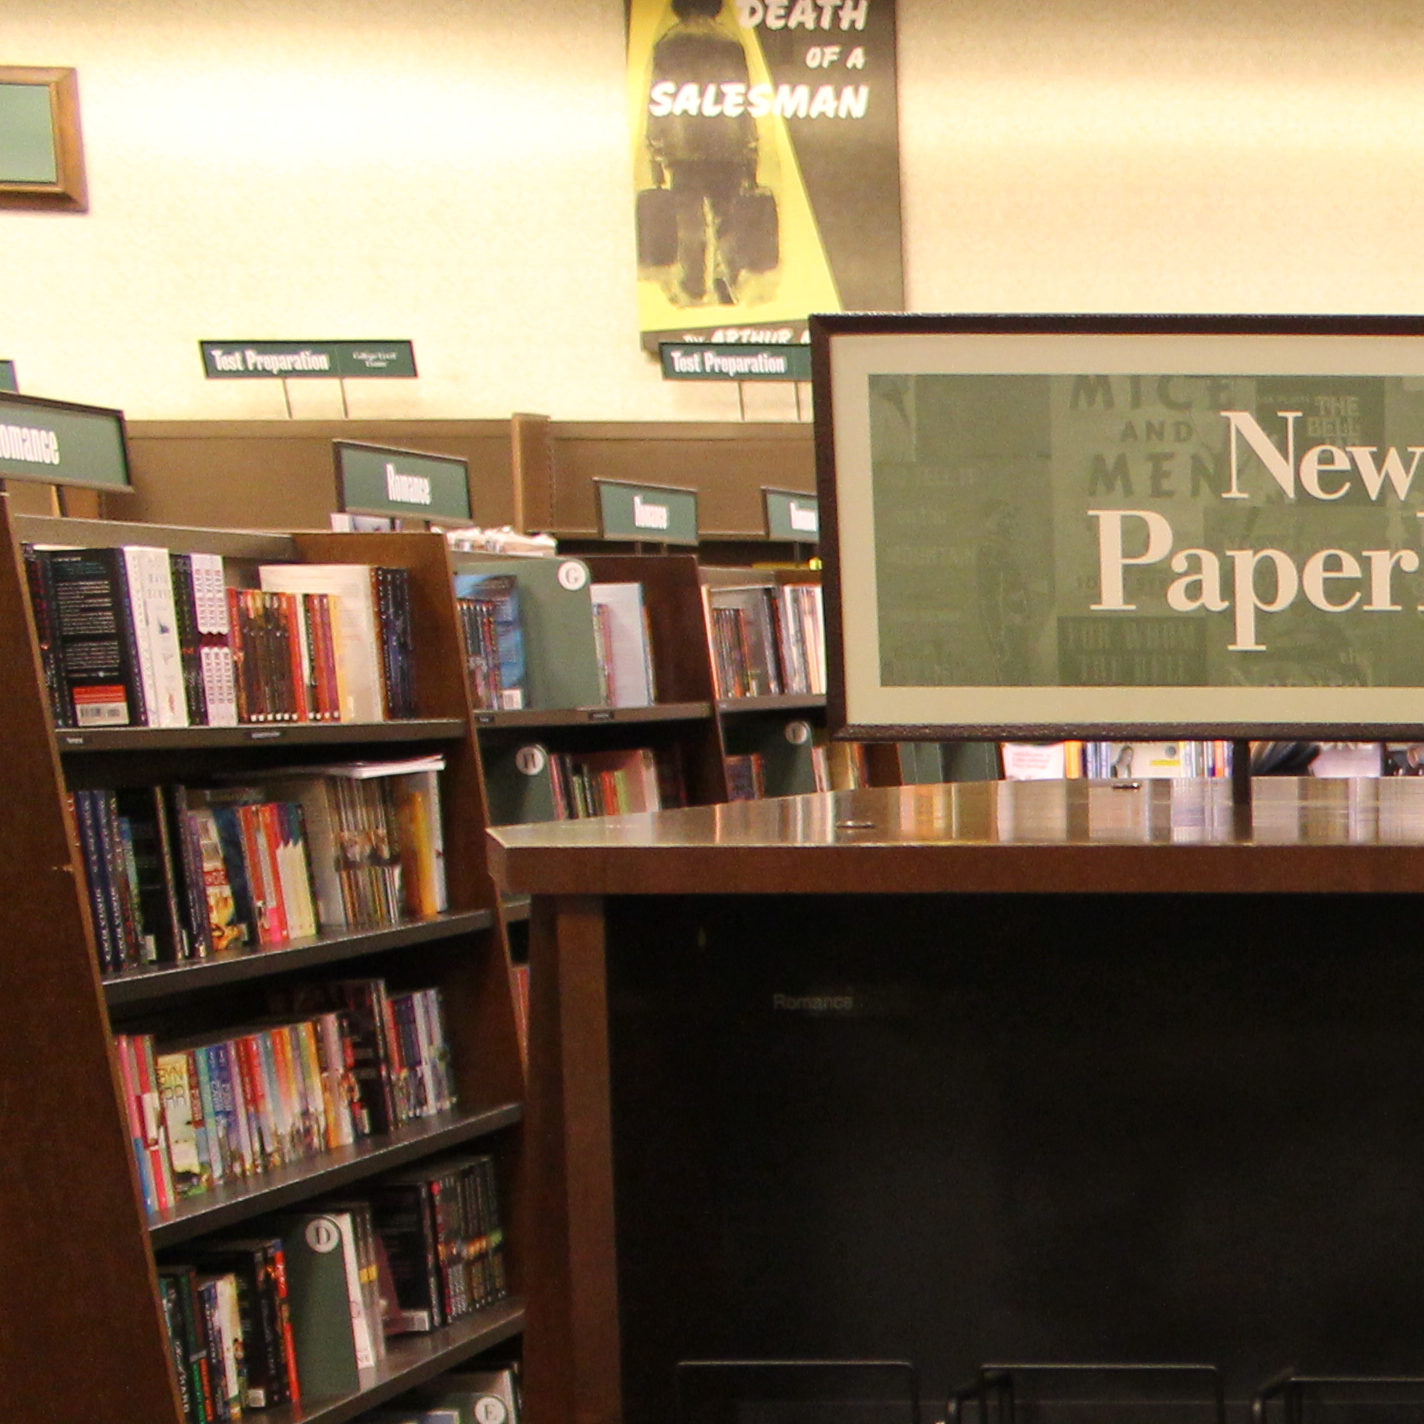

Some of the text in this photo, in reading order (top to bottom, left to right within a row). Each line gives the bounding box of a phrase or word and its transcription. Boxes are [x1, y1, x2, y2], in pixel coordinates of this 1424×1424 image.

[738, 0, 867, 30] DEATH
[805, 46, 864, 69] OF A
[650, 81, 868, 118] SALESMAN
[211, 350, 330, 375] Test Preparation
[671, 351, 787, 377] Test Preparation
[1315, 395, 1360, 416] THE
[1120, 420, 1195, 443] AND
[1307, 417, 1361, 437] BELL
[0, 424, 60, 466] omance
[386, 462, 432, 505] Romance
[564, 567, 580, 585] G
[523, 754, 536, 770] H
[315, 1226, 331, 1244] D
[485, 1404, 498, 1421] E
